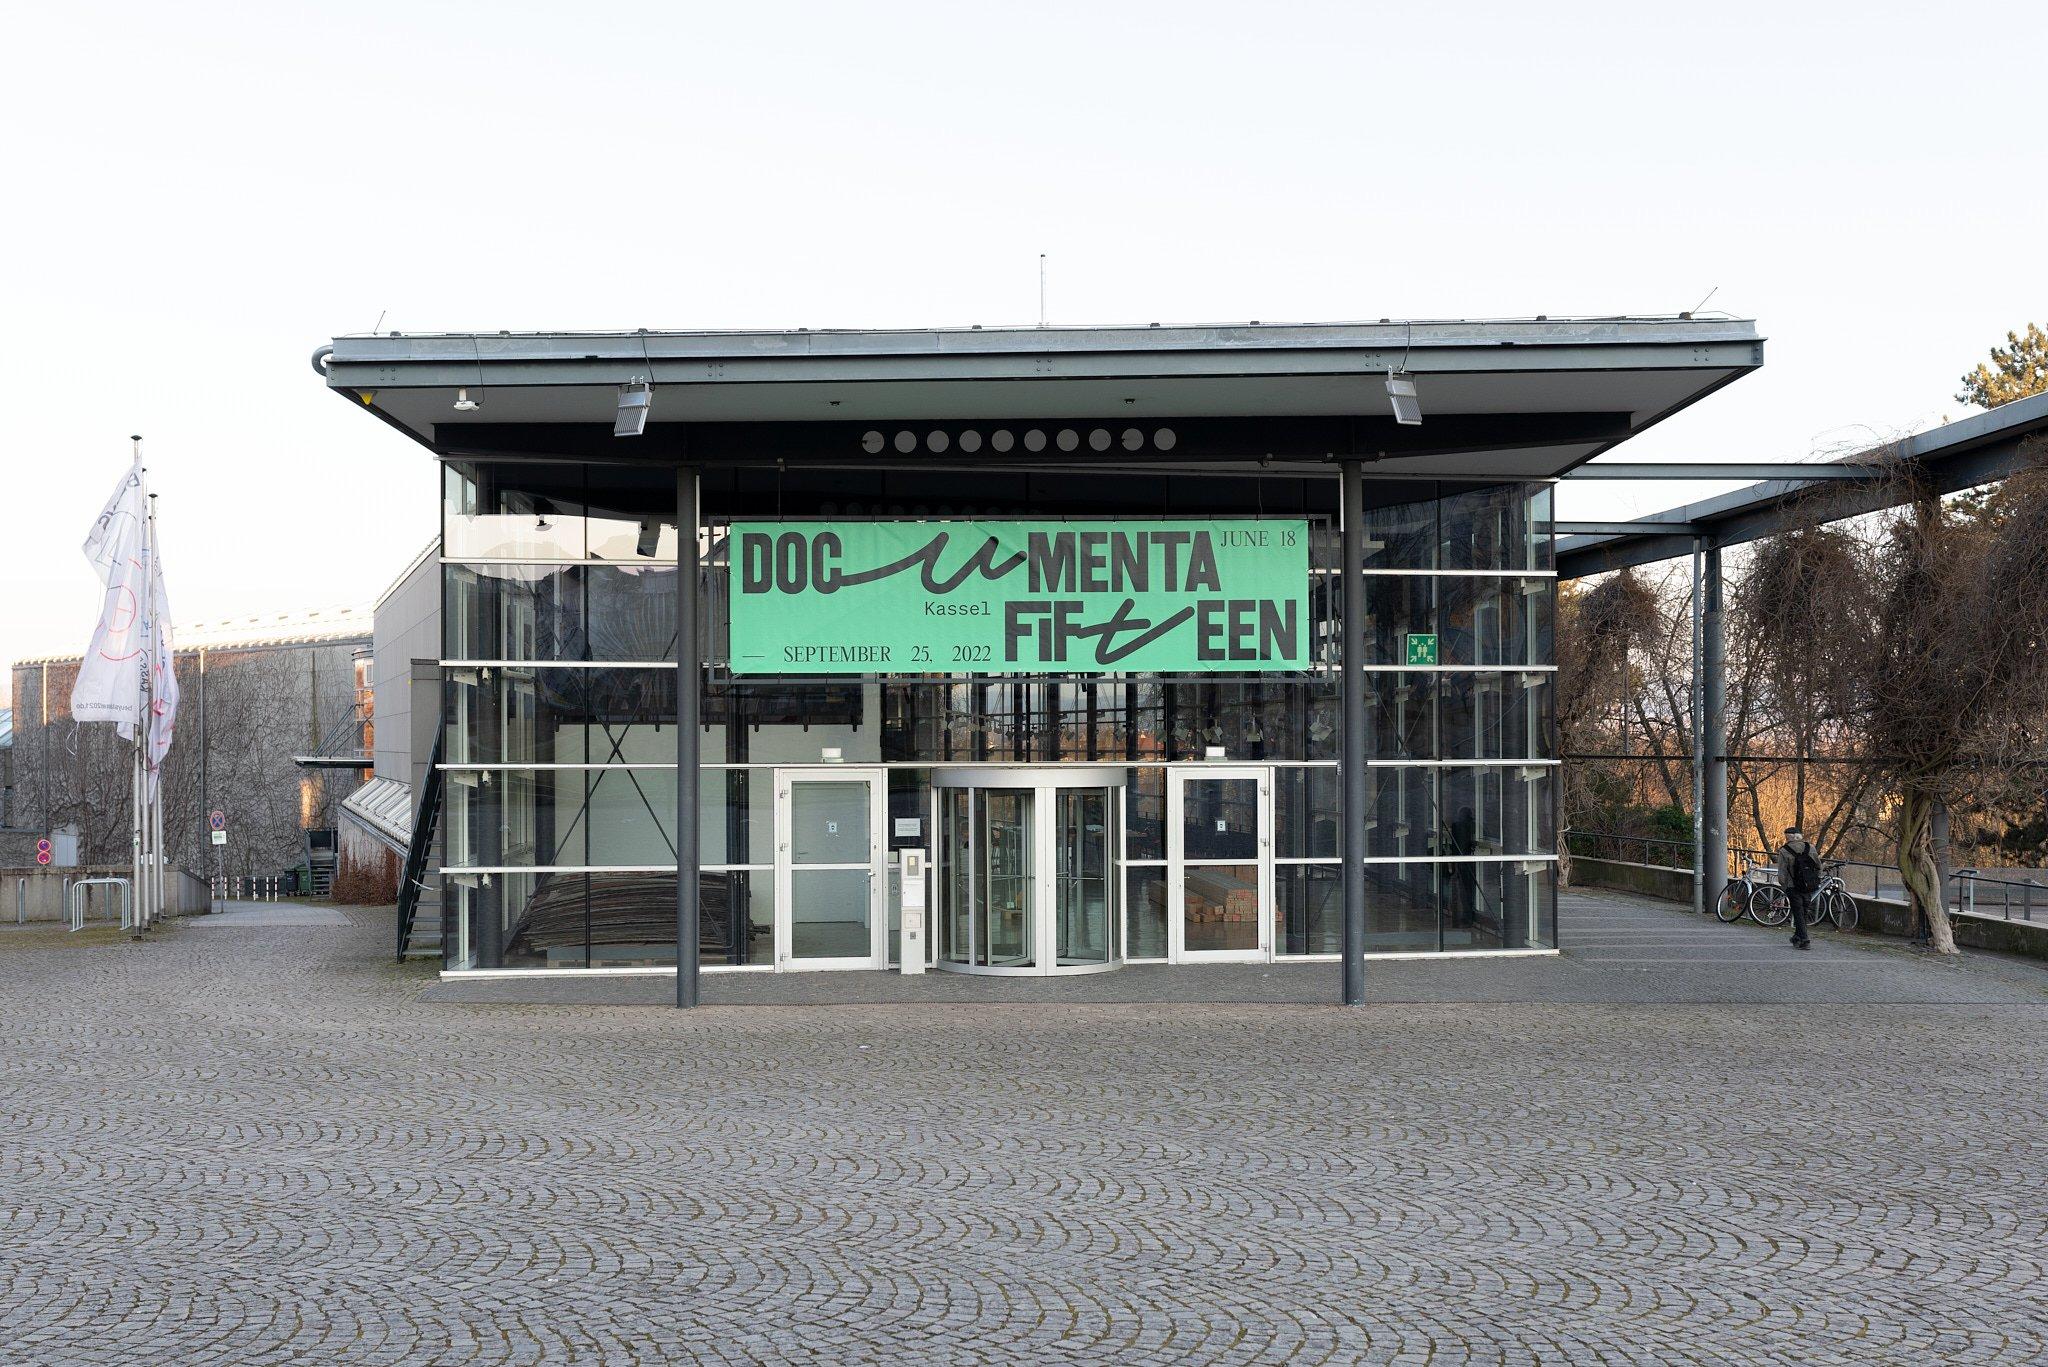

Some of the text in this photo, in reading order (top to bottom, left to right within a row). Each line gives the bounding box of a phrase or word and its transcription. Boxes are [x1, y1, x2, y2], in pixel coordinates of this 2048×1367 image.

[1221, 530, 1296, 547] JUNE 18
[924, 600, 991, 616] Kassel
[783, 645, 891, 662] SEPTEMBER
[910, 645, 934, 664] 25,
[952, 645, 991, 662] 2022
